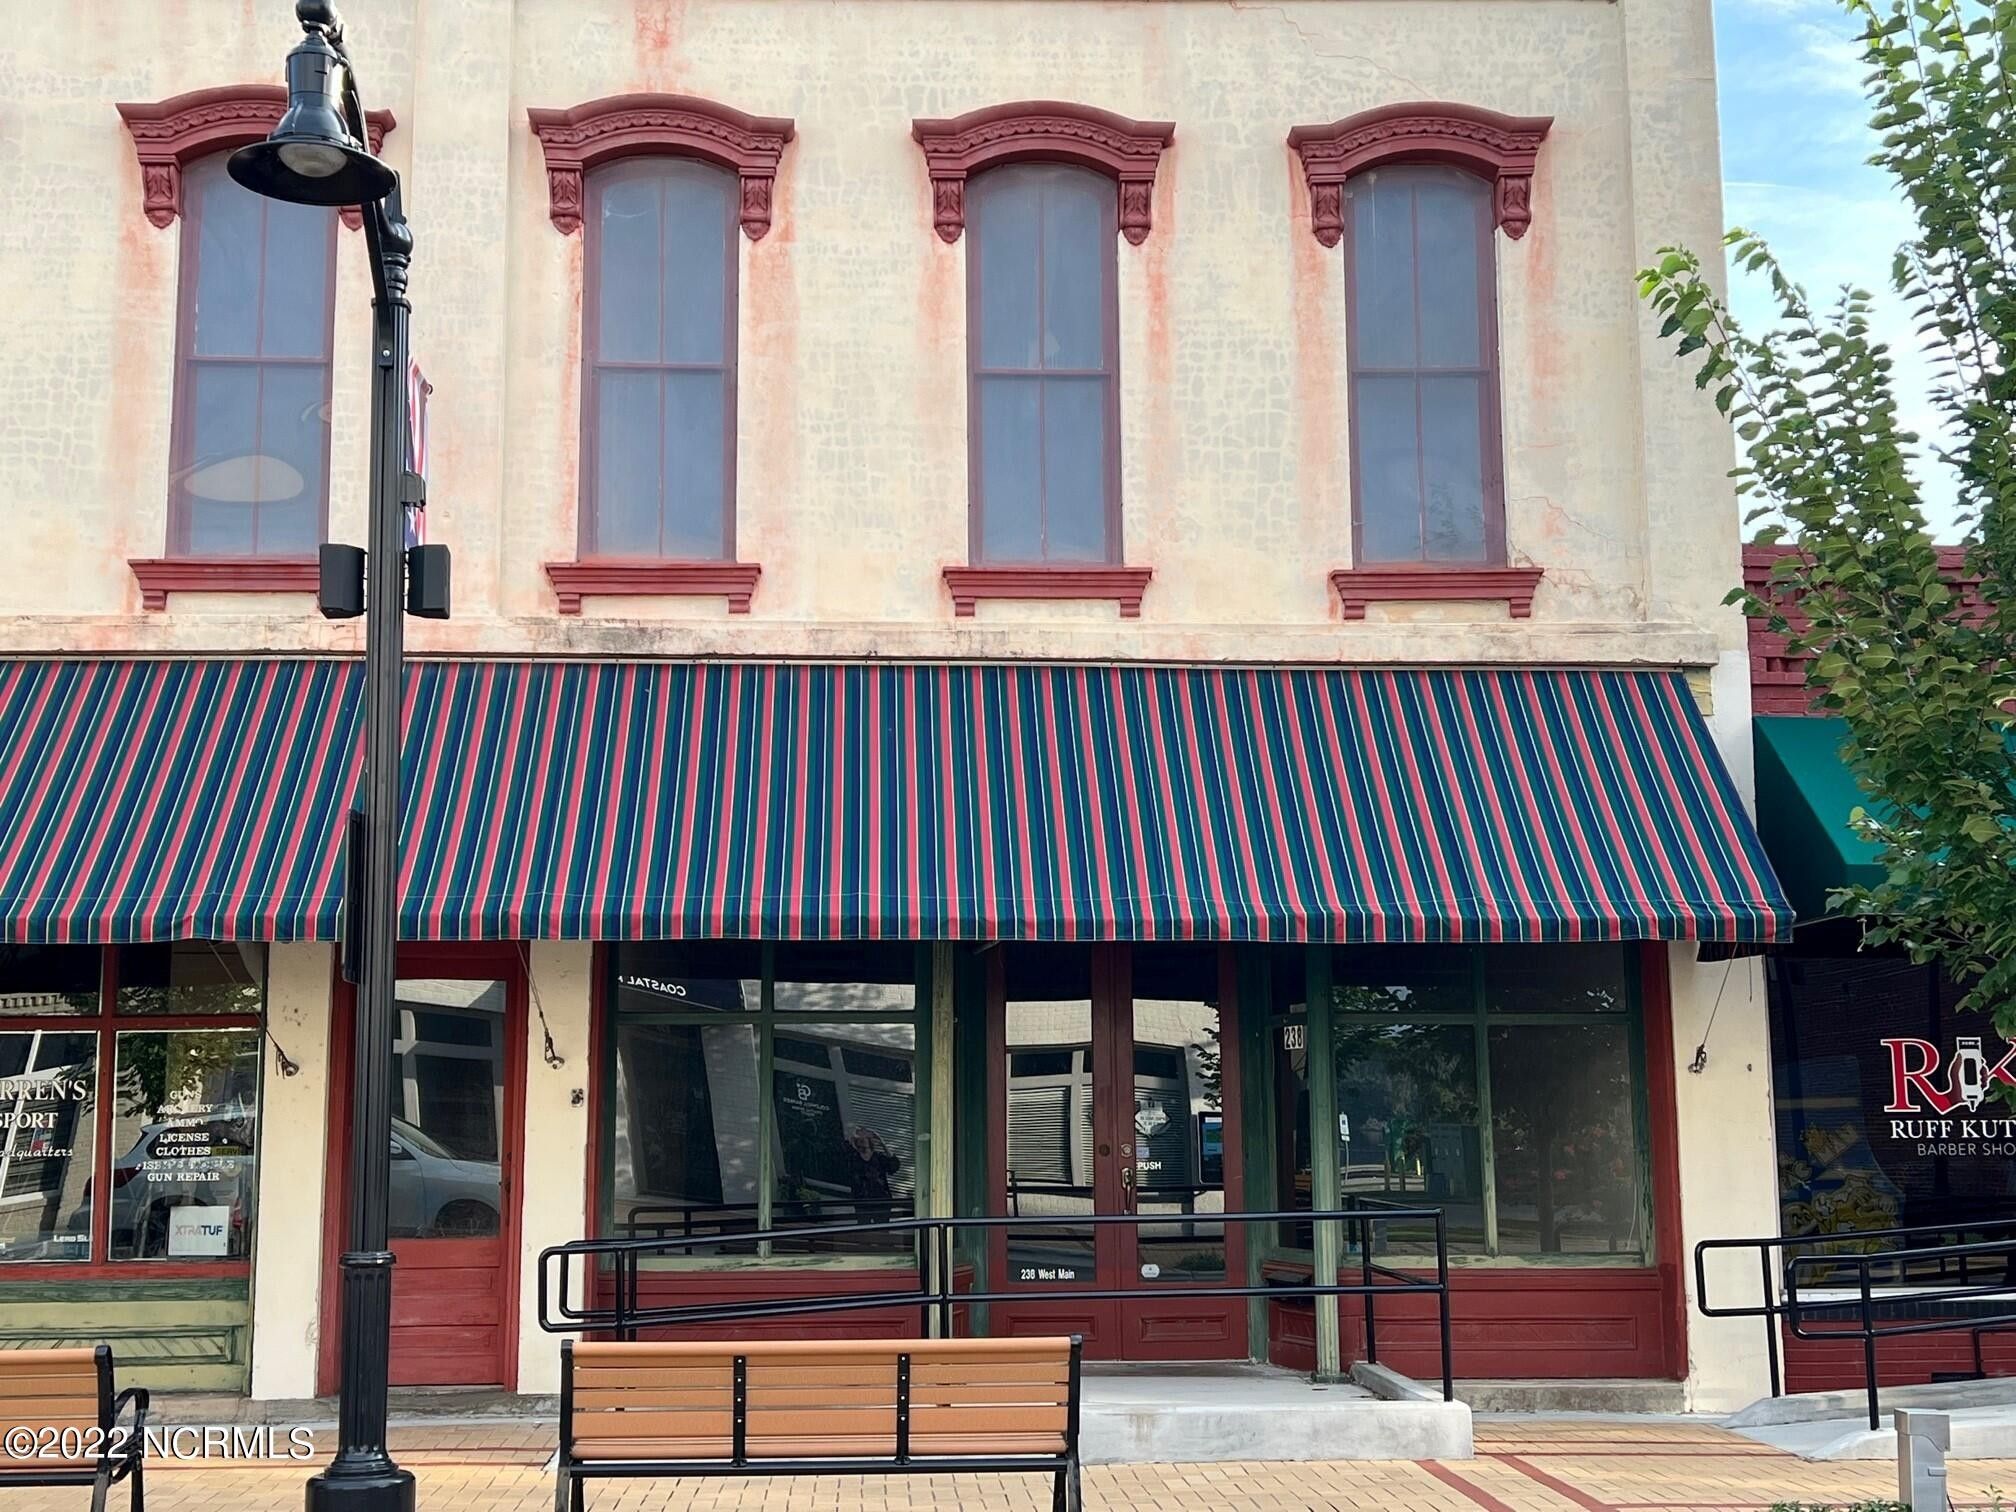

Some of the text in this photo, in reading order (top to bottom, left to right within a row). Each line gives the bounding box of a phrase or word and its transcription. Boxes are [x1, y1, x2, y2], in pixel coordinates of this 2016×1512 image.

[1285, 1026, 1303, 1048] 238
[1890, 1120, 1954, 1139] RUFF
[159, 1133, 210, 1143] LICENSE
[155, 1146, 211, 1157] CLOTHES
[1917, 1143, 1977, 1156] BARBER
[1136, 1161, 1162, 1171] PUSH
[147, 1172, 220, 1182] GUN REPAIR
[175, 1224, 223, 1236] XTRATUF
[1038, 1268, 1056, 1280] West
[1058, 1268, 1075, 1280] Main
